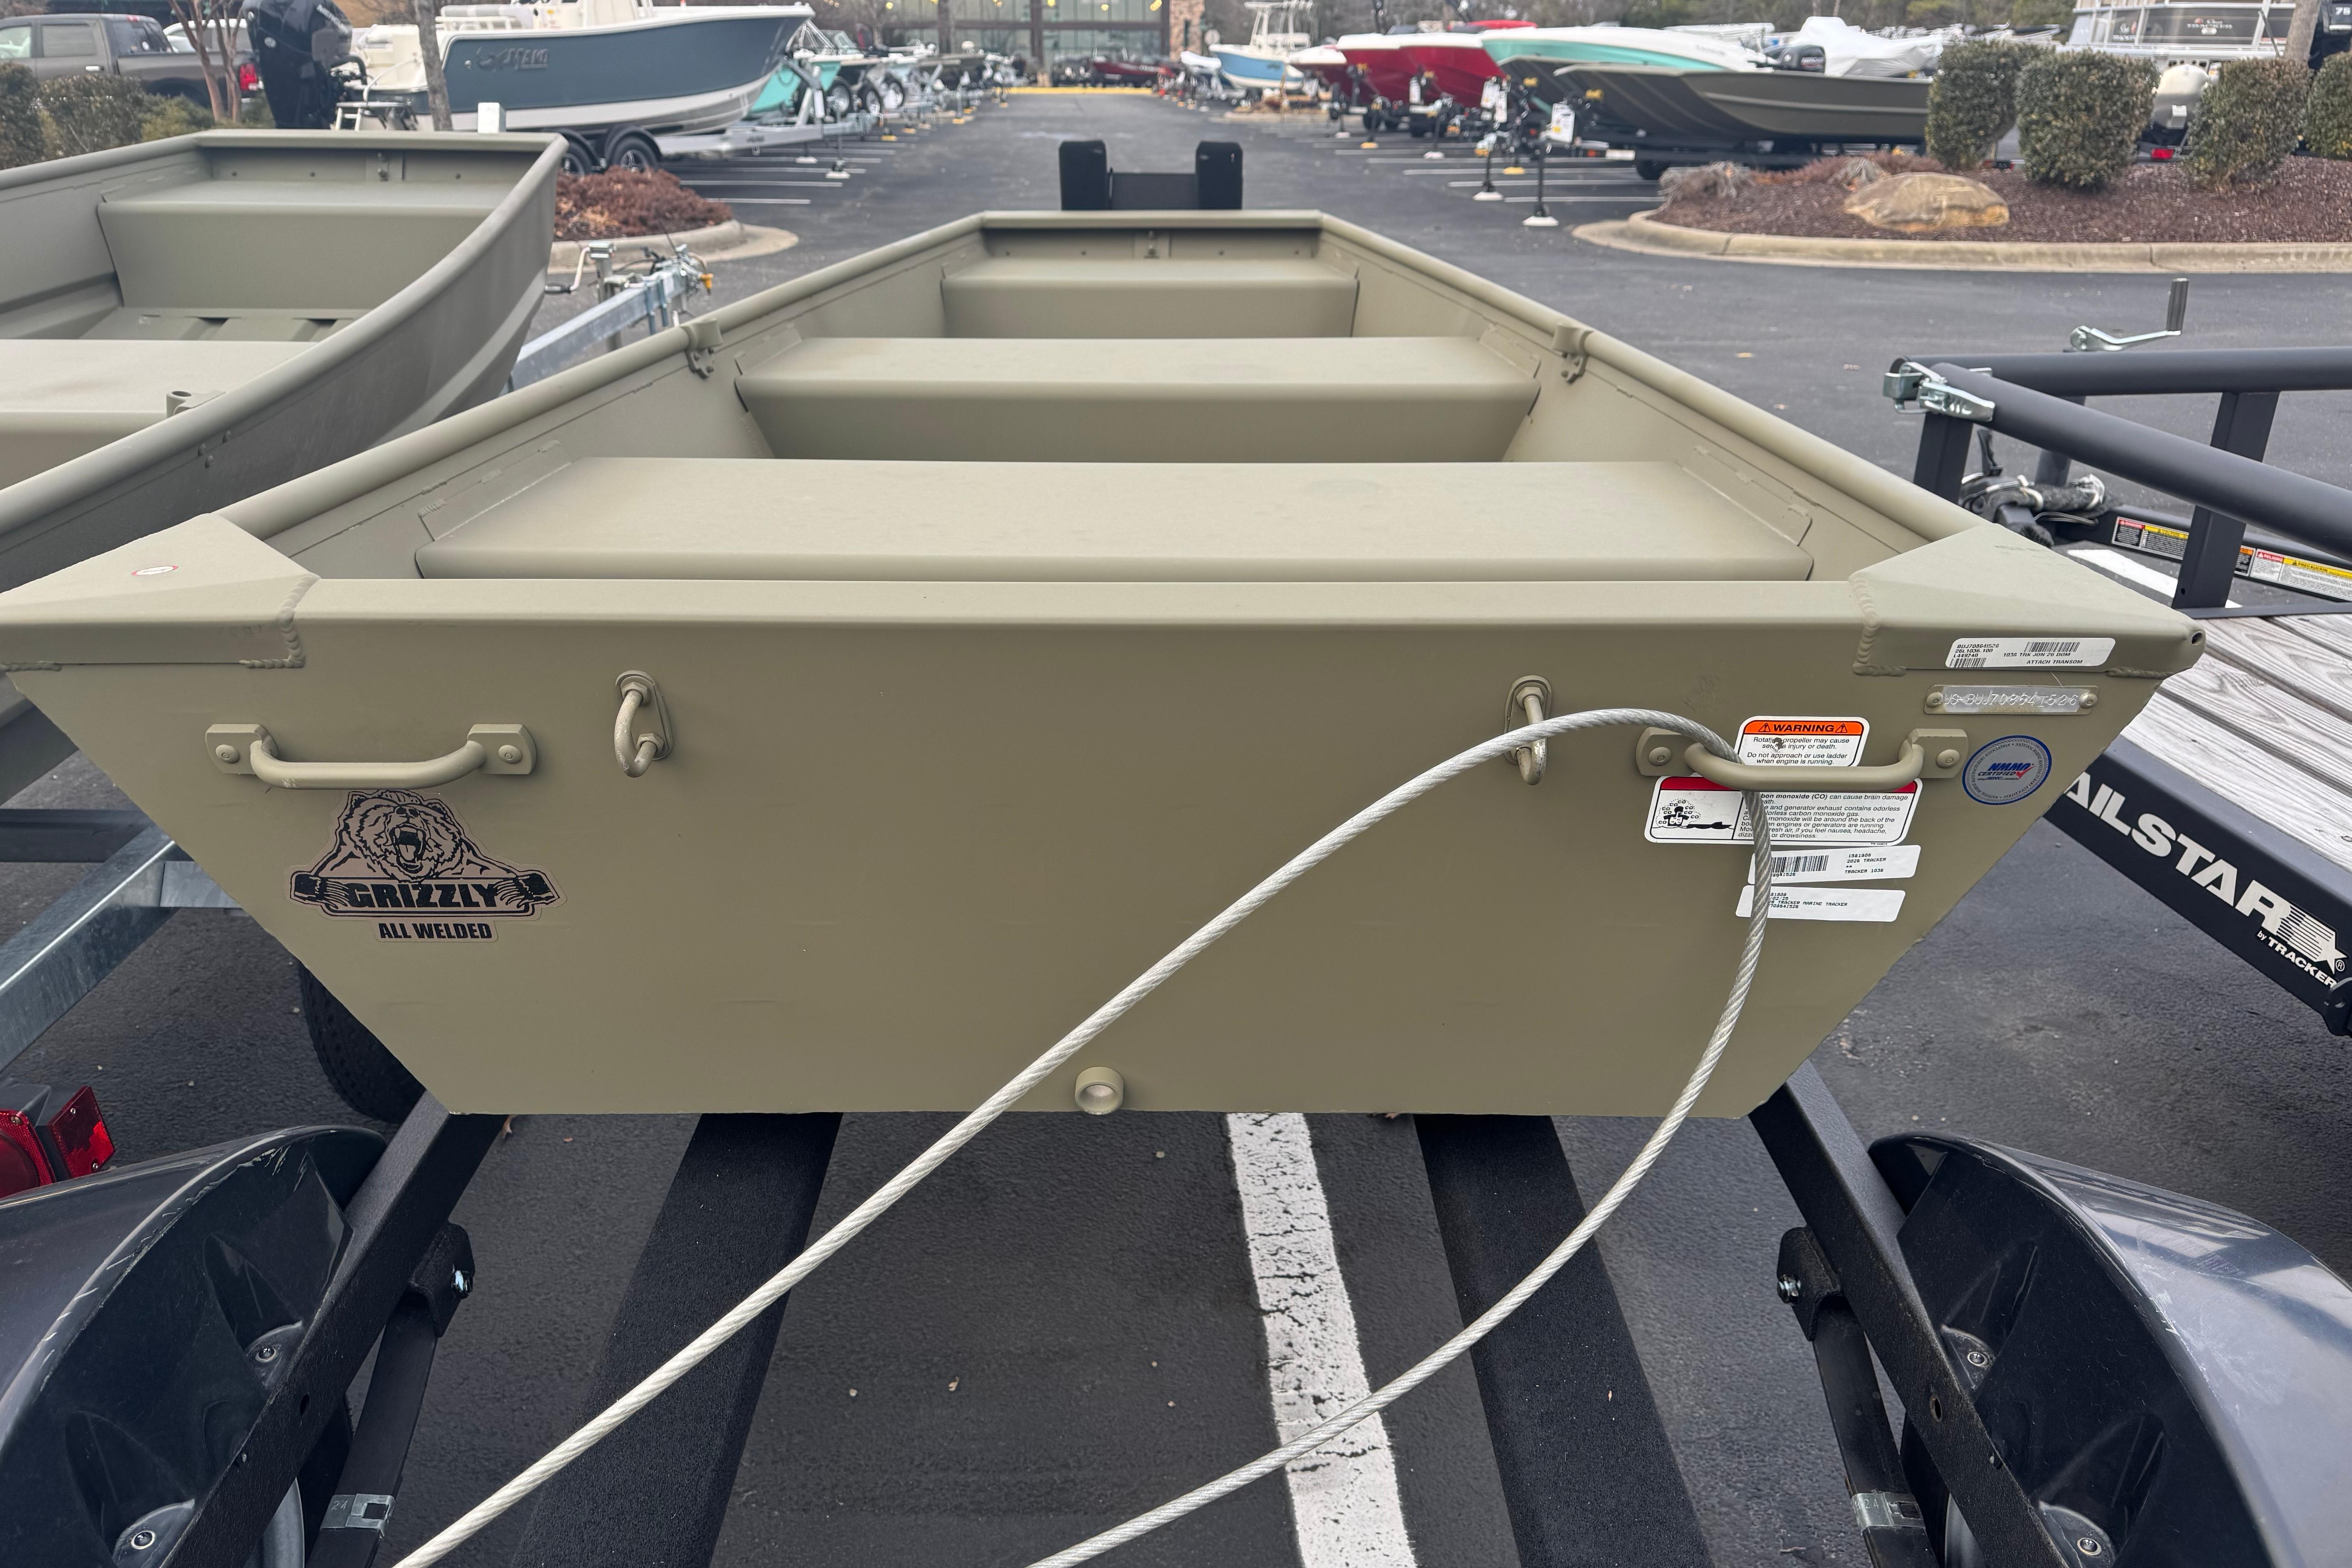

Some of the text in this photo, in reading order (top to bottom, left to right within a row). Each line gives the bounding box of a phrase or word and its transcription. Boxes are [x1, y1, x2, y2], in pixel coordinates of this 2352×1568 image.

[1773, 724, 1834, 732] WARNING
[2064, 771, 2292, 937] AILSTAR
[348, 883, 499, 908] GRIZZLY
[379, 922, 492, 939] ALL WELDED
[2257, 930, 2337, 988] by TRACKER
[331, 1500, 348, 1510] 24
